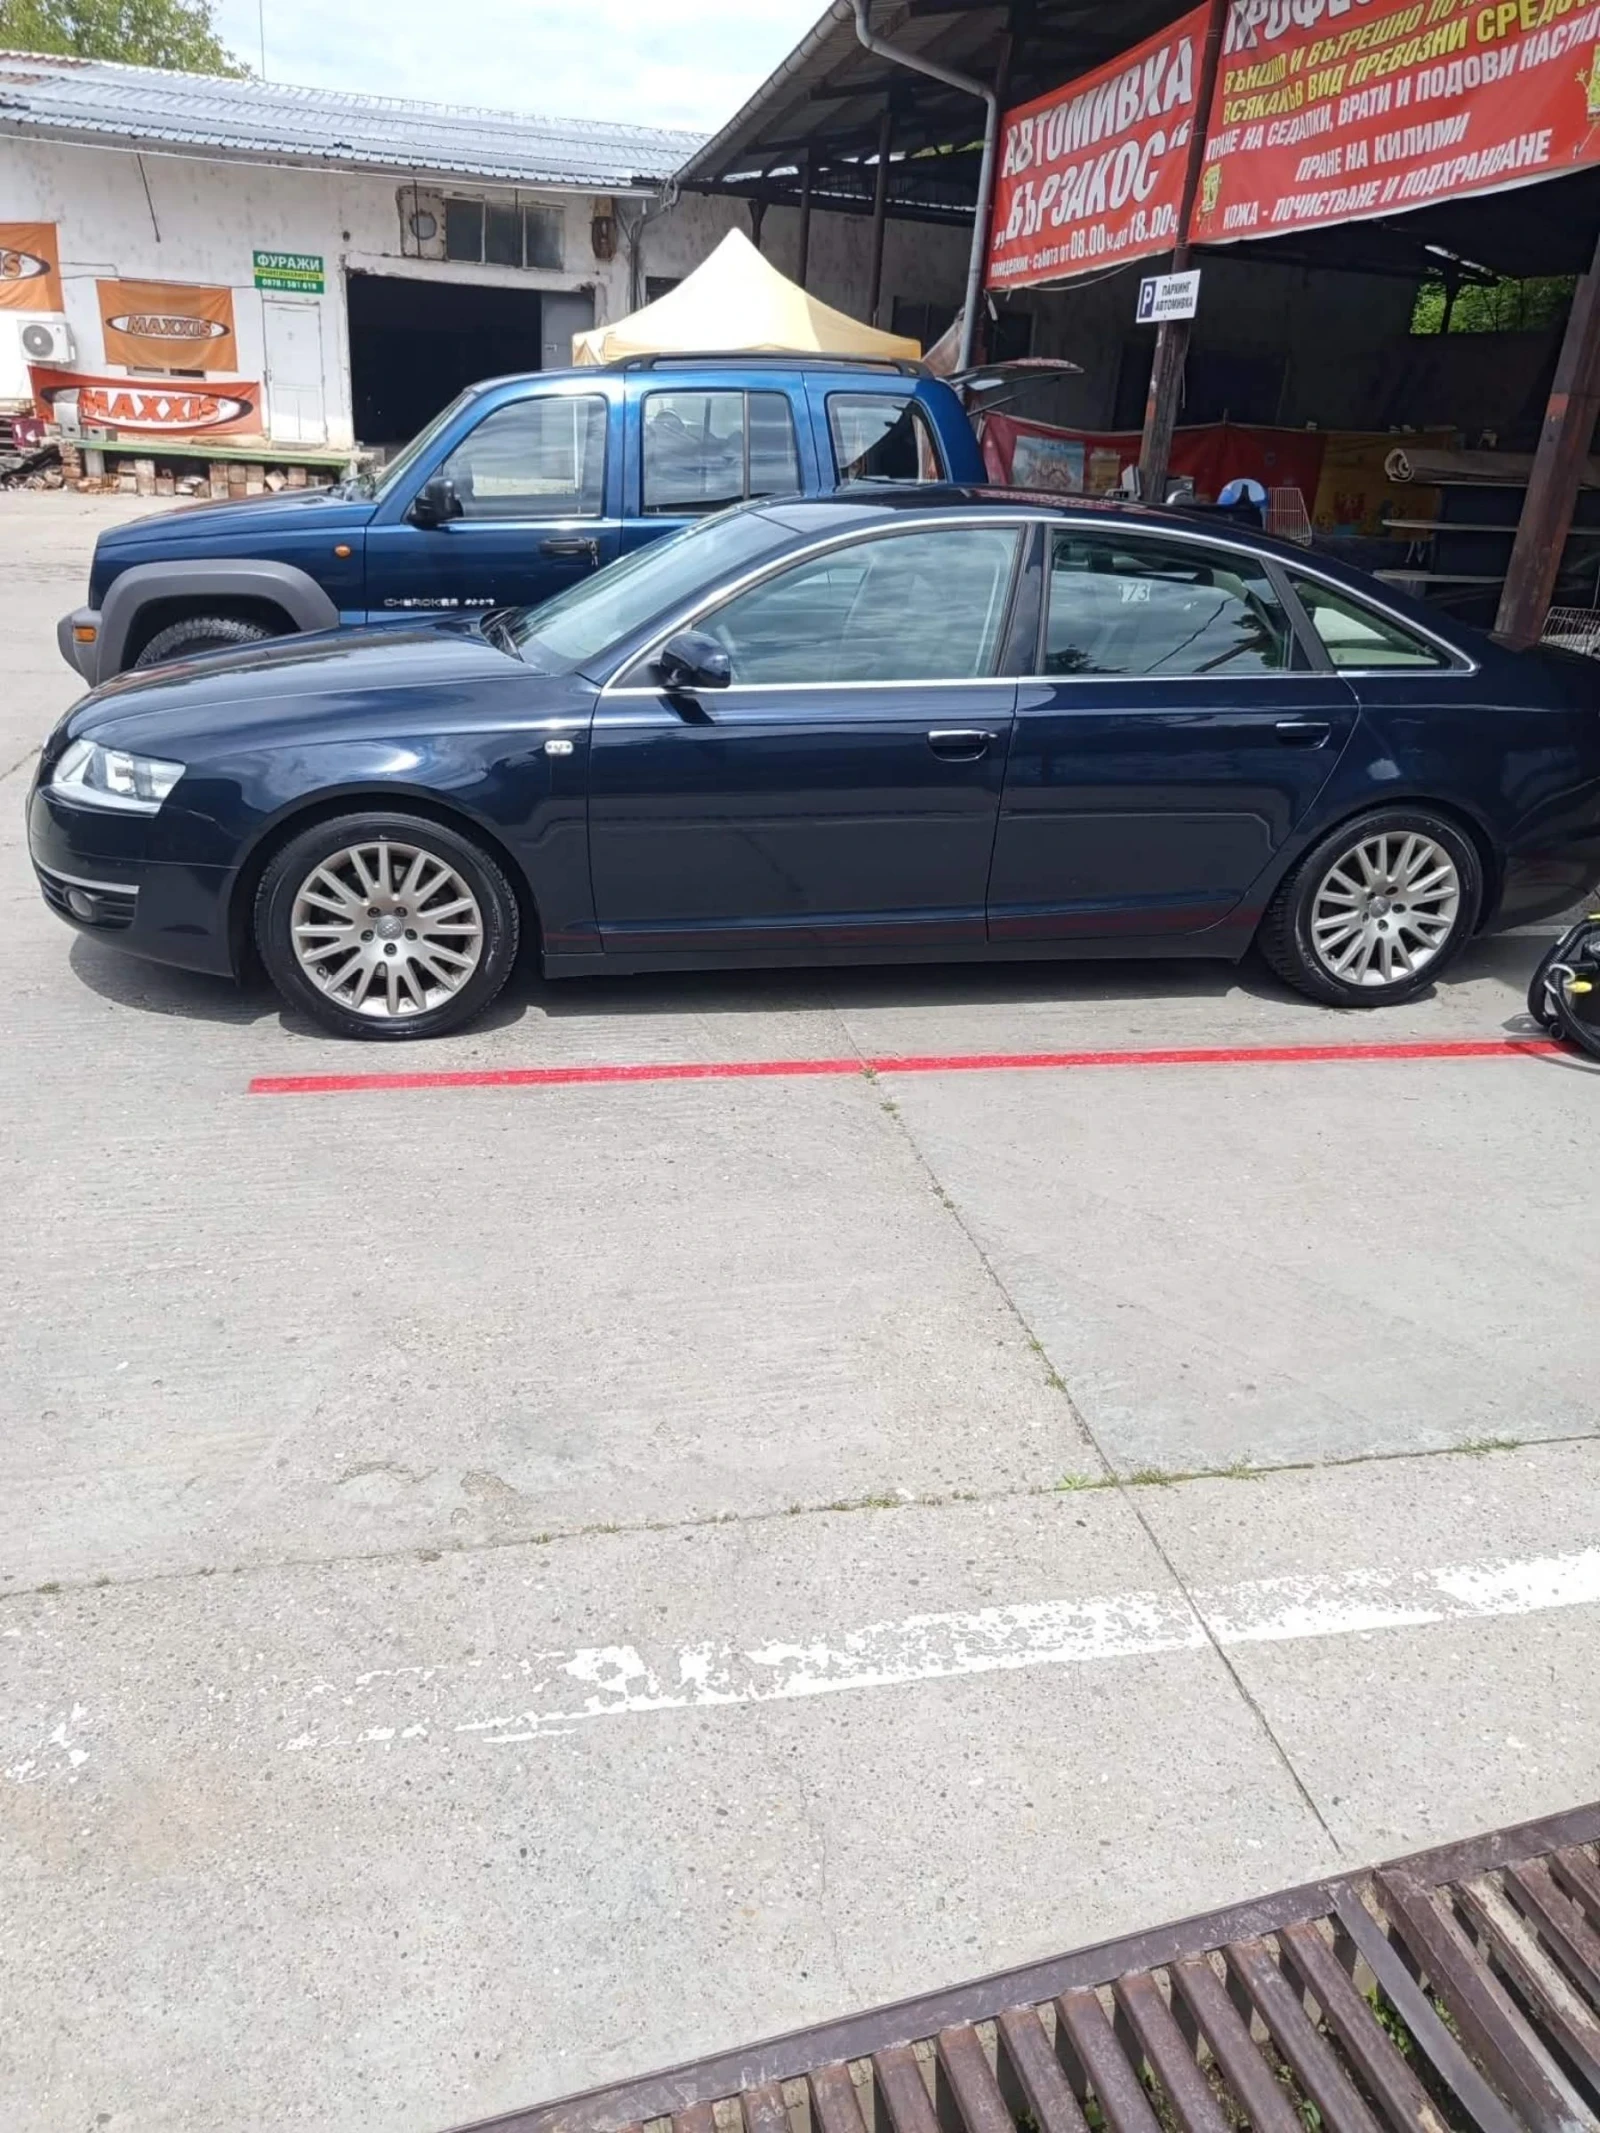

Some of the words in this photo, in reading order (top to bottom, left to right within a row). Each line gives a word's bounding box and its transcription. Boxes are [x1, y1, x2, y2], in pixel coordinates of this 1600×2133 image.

[1290, 46, 1307, 74] И
[1306, 3, 1424, 68] ВЪТРЕШНО
[1223, 80, 1303, 125] ВСЯКАКЪВ
[1308, 63, 1348, 102] ВИД
[1348, 16, 1468, 87] ПРЕВОЗНИ
[1002, 36, 1192, 178] АВТОМИВКА
[1206, 128, 1241, 161] ПРАНЕ
[1240, 125, 1264, 150] НА
[1338, 83, 1391, 127] ВРАТИ
[1395, 76, 1411, 108] И
[1416, 44, 1518, 102] ПОДОВИ
[1295, 147, 1343, 182] ПРАНЕ
[1345, 140, 1368, 171] НА
[1374, 112, 1470, 164] КИЛИМИ
[1223, 201, 1259, 230] КОЖА
[1271, 180, 1381, 222] ПОЧИСТВАНЕ
[1380, 175, 1400, 203] И
[1129, 203, 1172, 244] 18.00
[257, 254, 320, 271] ФУРАЖИ
[1155, 297, 1193, 311] АВТОМИВКА
[1161, 281, 1191, 296] ПАРКИНГ
[127, 315, 213, 339] MAXXIS
[78, 387, 220, 423] MAXXIS
[384, 598, 459, 607] CHEROKEE
